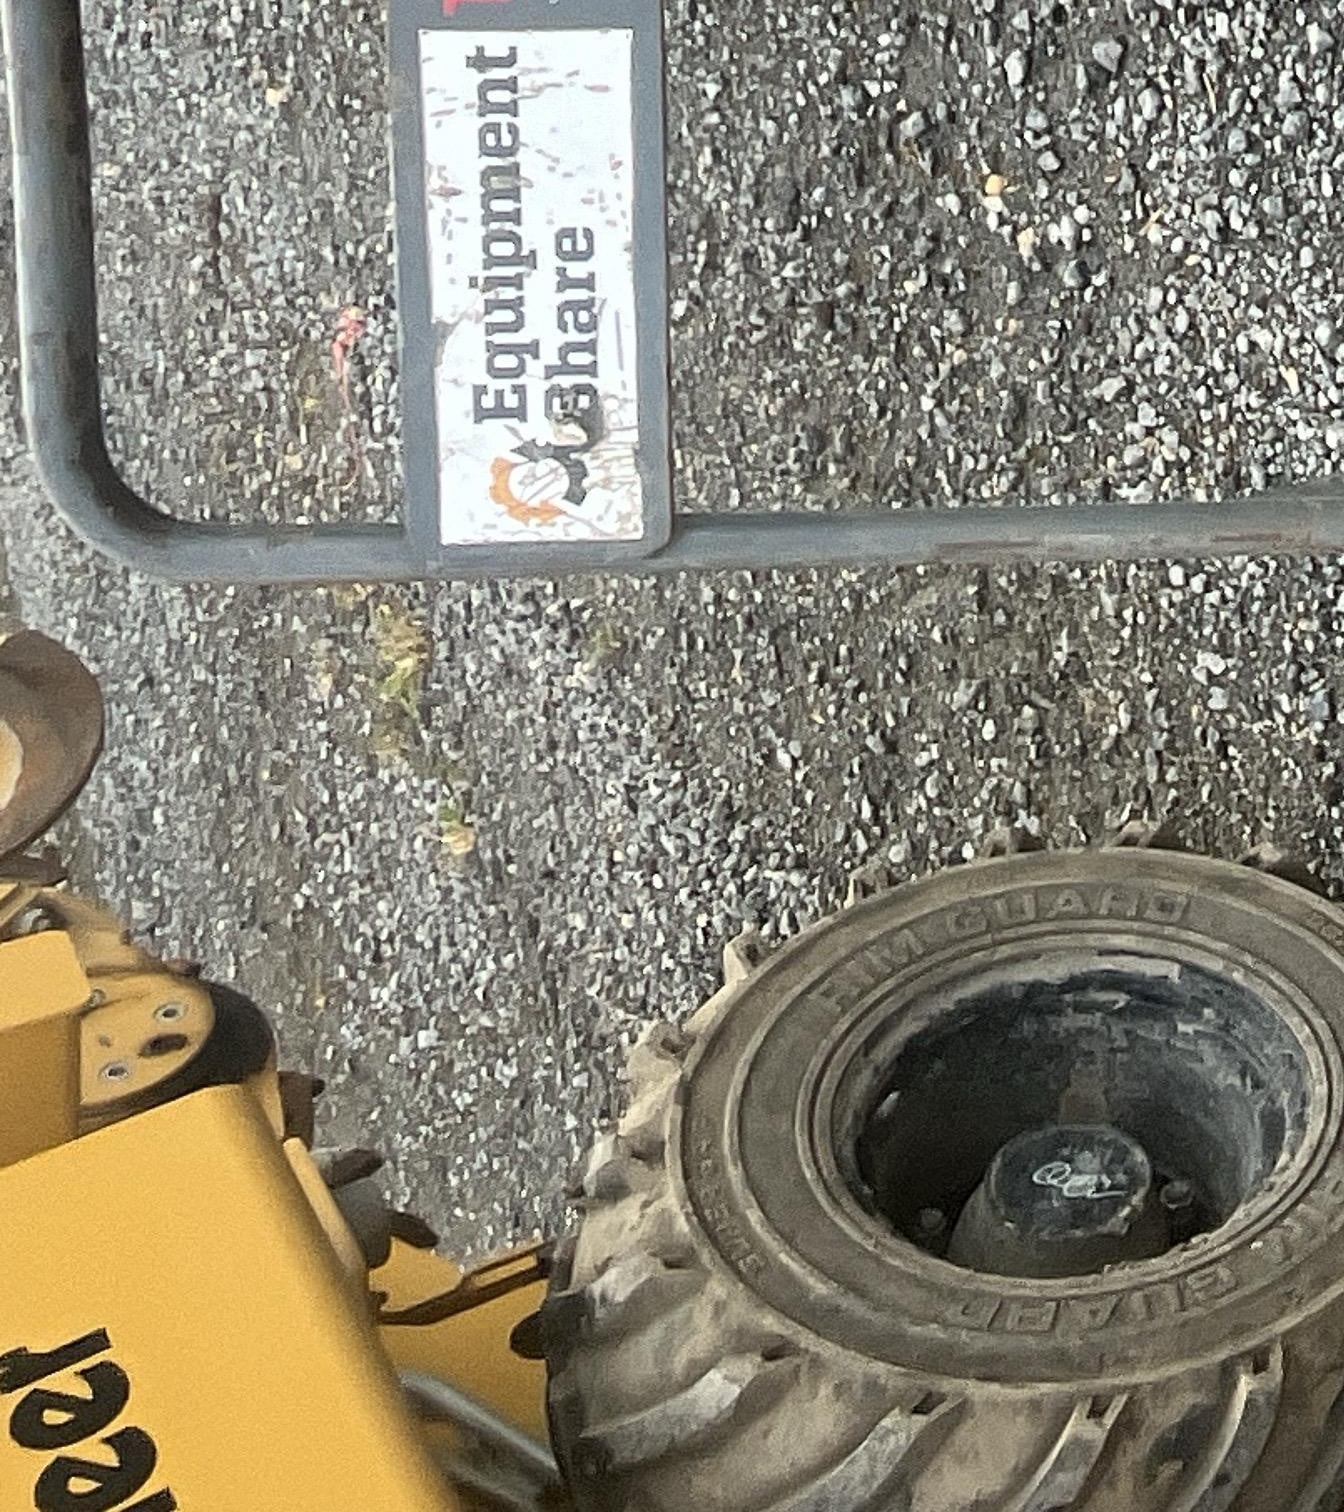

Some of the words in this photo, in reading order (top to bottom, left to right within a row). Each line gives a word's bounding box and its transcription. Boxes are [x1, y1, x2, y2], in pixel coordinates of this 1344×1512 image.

[465, 44, 541, 425] Equipment
[544, 226, 602, 422] Share
[0, 1326, 178, 1512] eer
